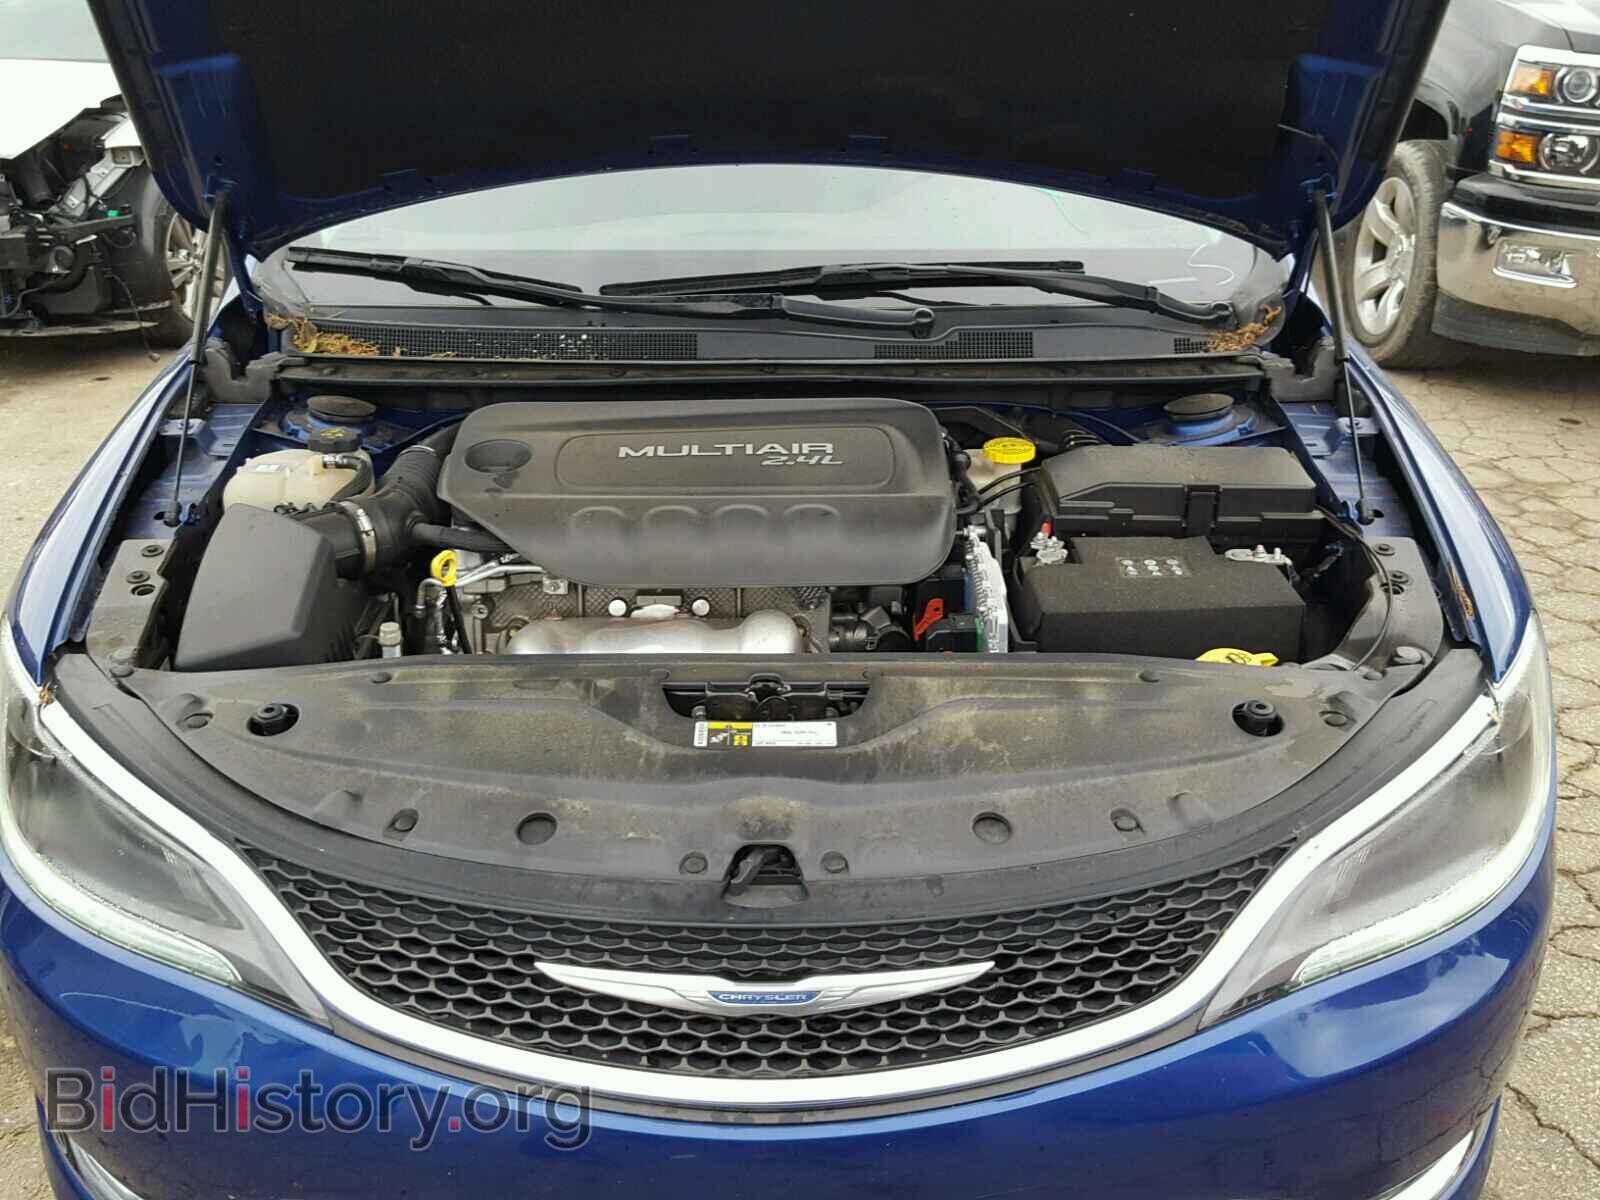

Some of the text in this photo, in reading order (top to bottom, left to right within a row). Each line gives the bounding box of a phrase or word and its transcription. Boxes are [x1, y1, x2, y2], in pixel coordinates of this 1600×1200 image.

[618, 443, 833, 457] MULTIAIR
[761, 455, 843, 465] 2.4L
[718, 993, 808, 1001] CHRYSLER
